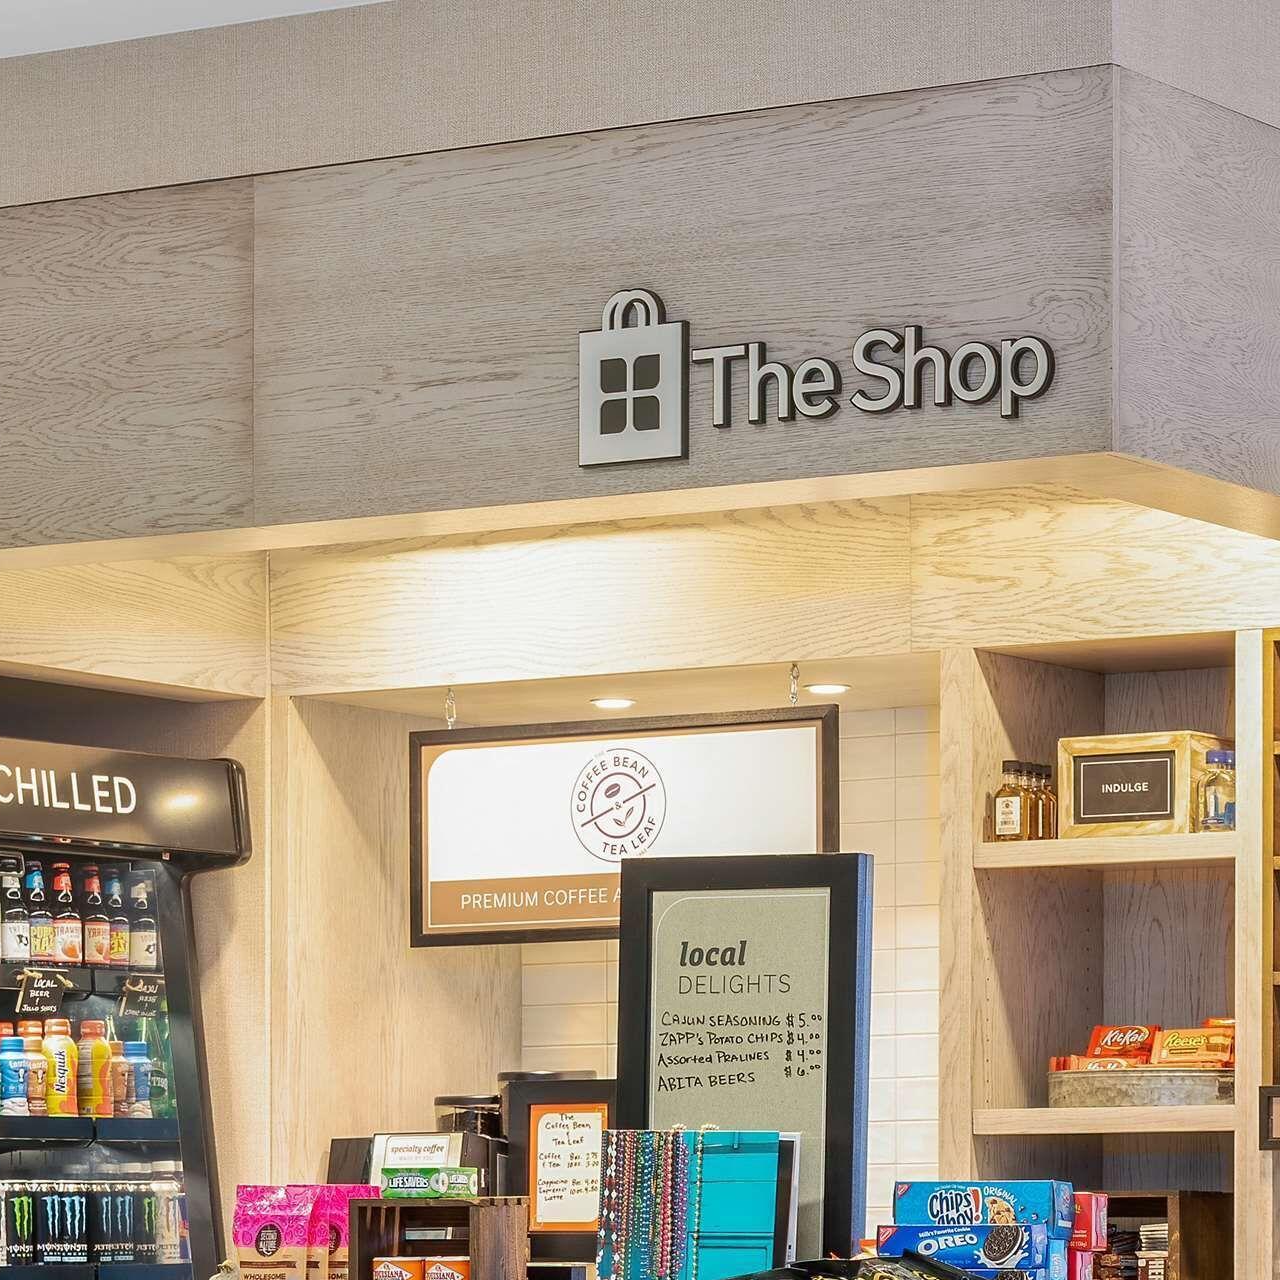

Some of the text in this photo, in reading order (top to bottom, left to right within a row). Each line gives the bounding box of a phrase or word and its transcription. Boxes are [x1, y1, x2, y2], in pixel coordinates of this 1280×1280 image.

[692, 325, 1055, 428] The Shop
[576, 756, 648, 812] COFFEE BEAN
[1101, 782, 1149, 794] INDULGE
[601, 816, 656, 855] TEA LEAF
[461, 888, 608, 910] PREMIUM COFFEE
[680, 940, 748, 967] local
[30, 990, 50, 998] BEER
[34, 979, 58, 988] LOCAL
[678, 974, 791, 994] DELIGHTS
[661, 1012, 705, 1026] CAJUN
[709, 1014, 781, 1027] SEASONING
[748, 1032, 784, 1044] CHIPS
[716, 1051, 770, 1064] PRALINES
[55, 1050, 66, 1094] Nesquik
[658, 1072, 756, 1092] ABITA BEERS
[424, 1144, 444, 1154] coffee
[928, 1189, 971, 1218] Chips
[984, 1185, 1017, 1207] ORIGINAL
[918, 1234, 978, 1256] OREO
